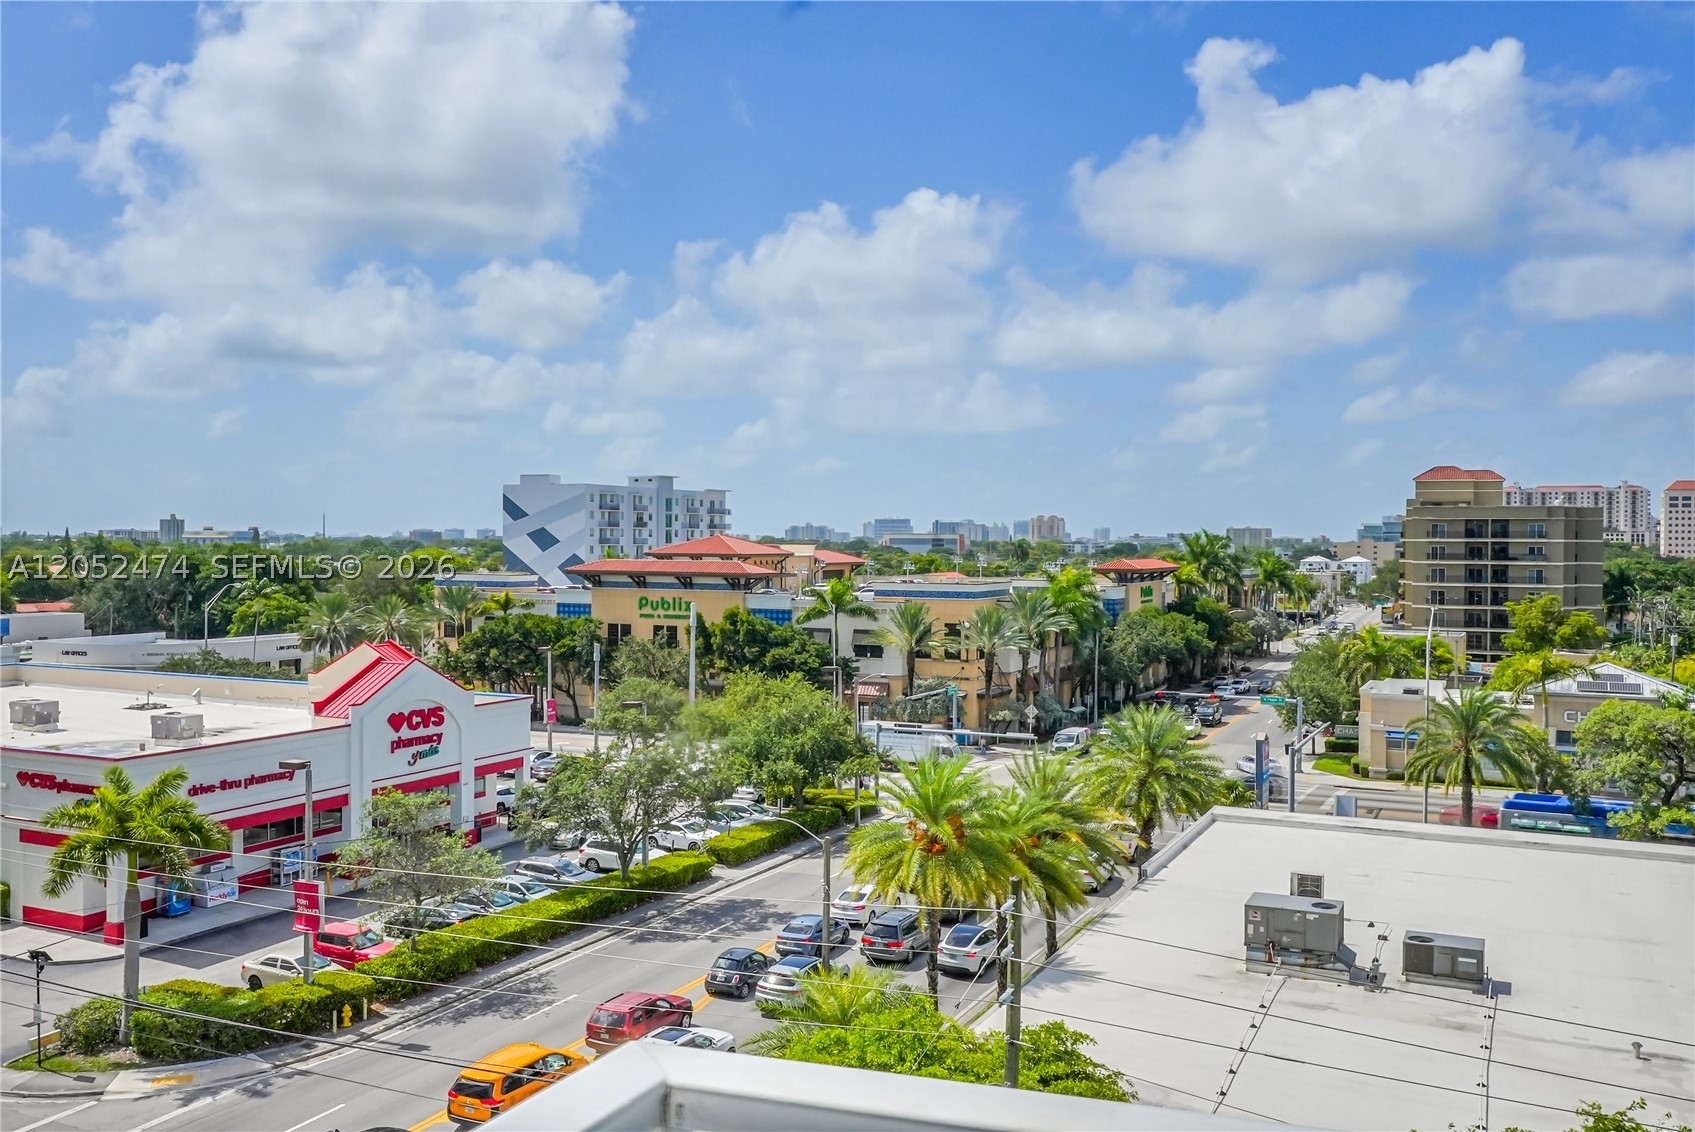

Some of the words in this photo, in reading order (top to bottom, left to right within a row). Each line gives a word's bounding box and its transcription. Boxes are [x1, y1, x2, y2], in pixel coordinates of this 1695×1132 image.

[638, 596, 692, 612] Publix
[406, 706, 445, 731] CVS
[391, 732, 443, 754] pharmacy
[28, 773, 57, 790] CVS
[187, 779, 242, 797] drive-thru
[244, 769, 295, 789] pharmacy
[296, 897, 309, 906] open
